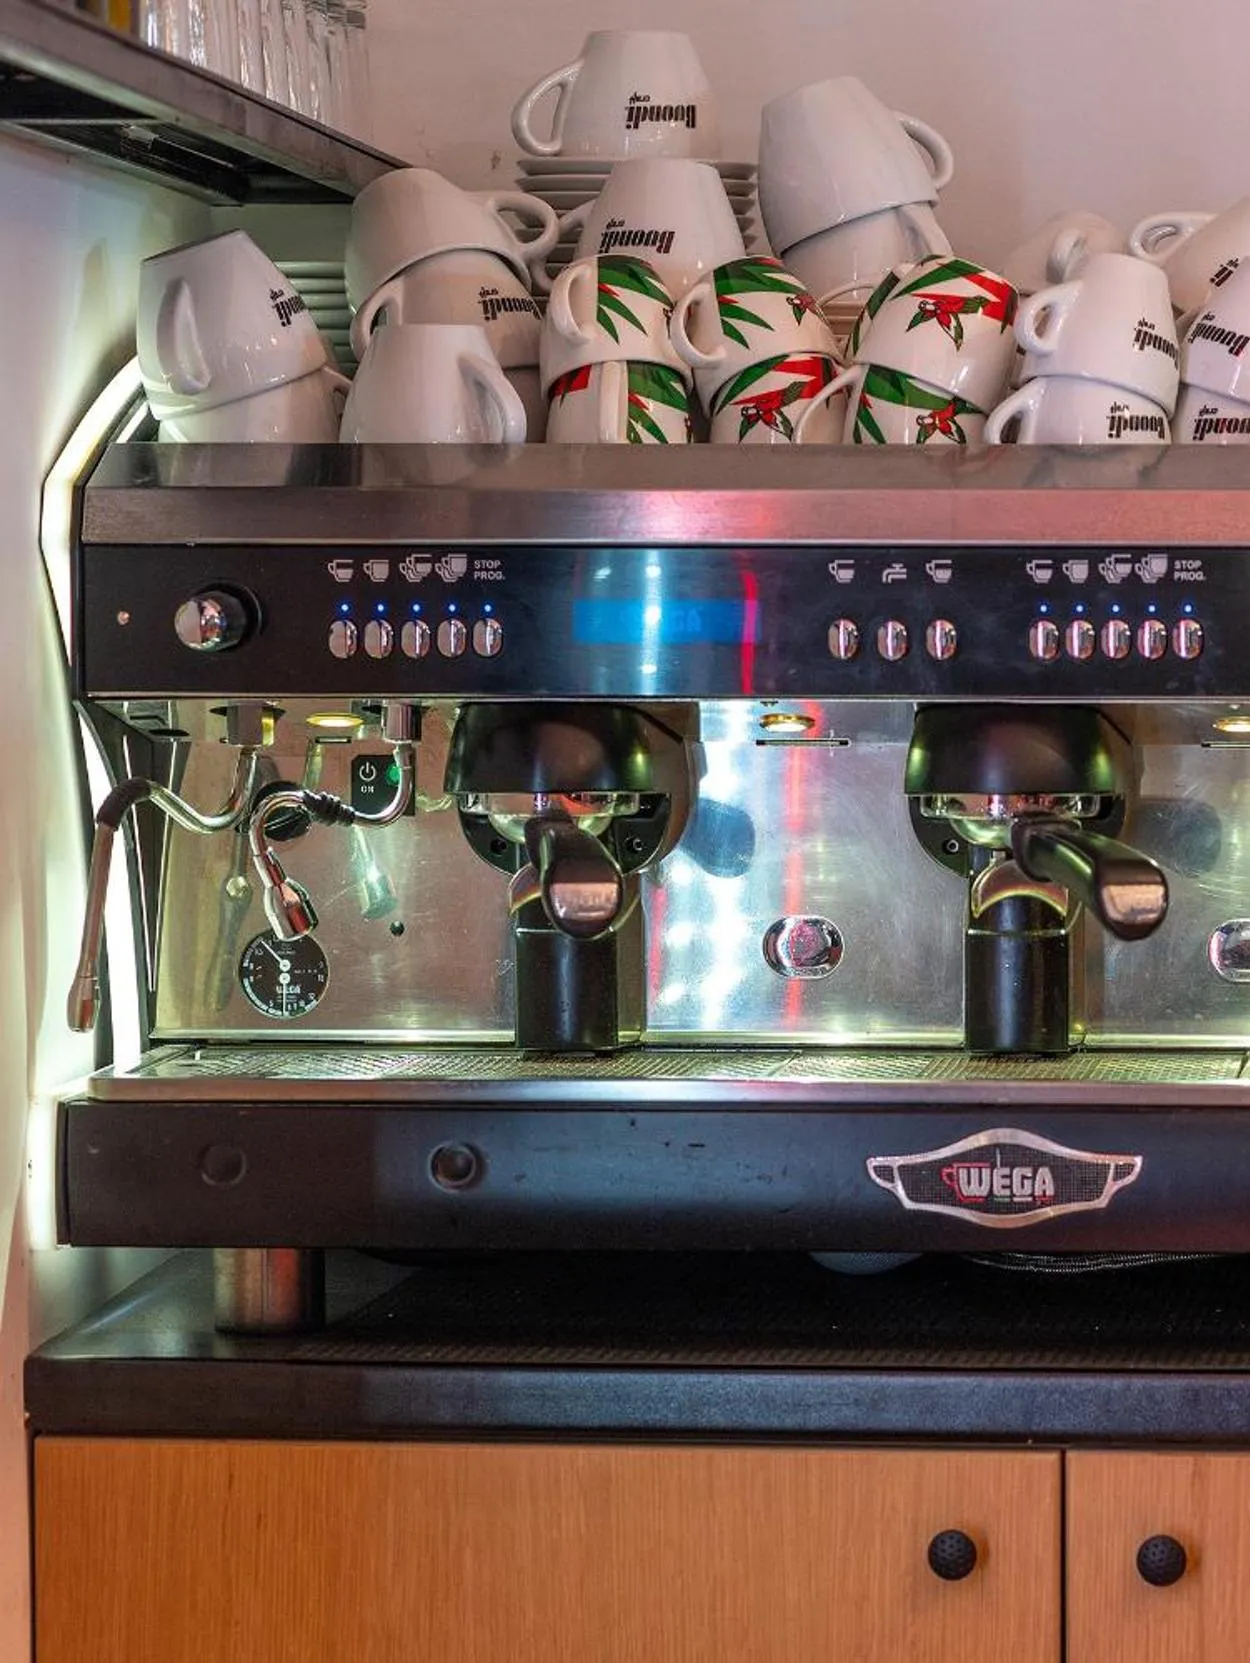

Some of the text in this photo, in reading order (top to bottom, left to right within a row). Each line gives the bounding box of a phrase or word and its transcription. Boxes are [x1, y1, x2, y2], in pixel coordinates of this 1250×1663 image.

[625, 103, 697, 129] Buondi
[600, 229, 675, 254] Buondi
[1107, 415, 1166, 439] Buondi
[474, 560, 501, 569] STOP
[1174, 560, 1202, 569] STOP
[958, 1166, 1055, 1197] WEGA
